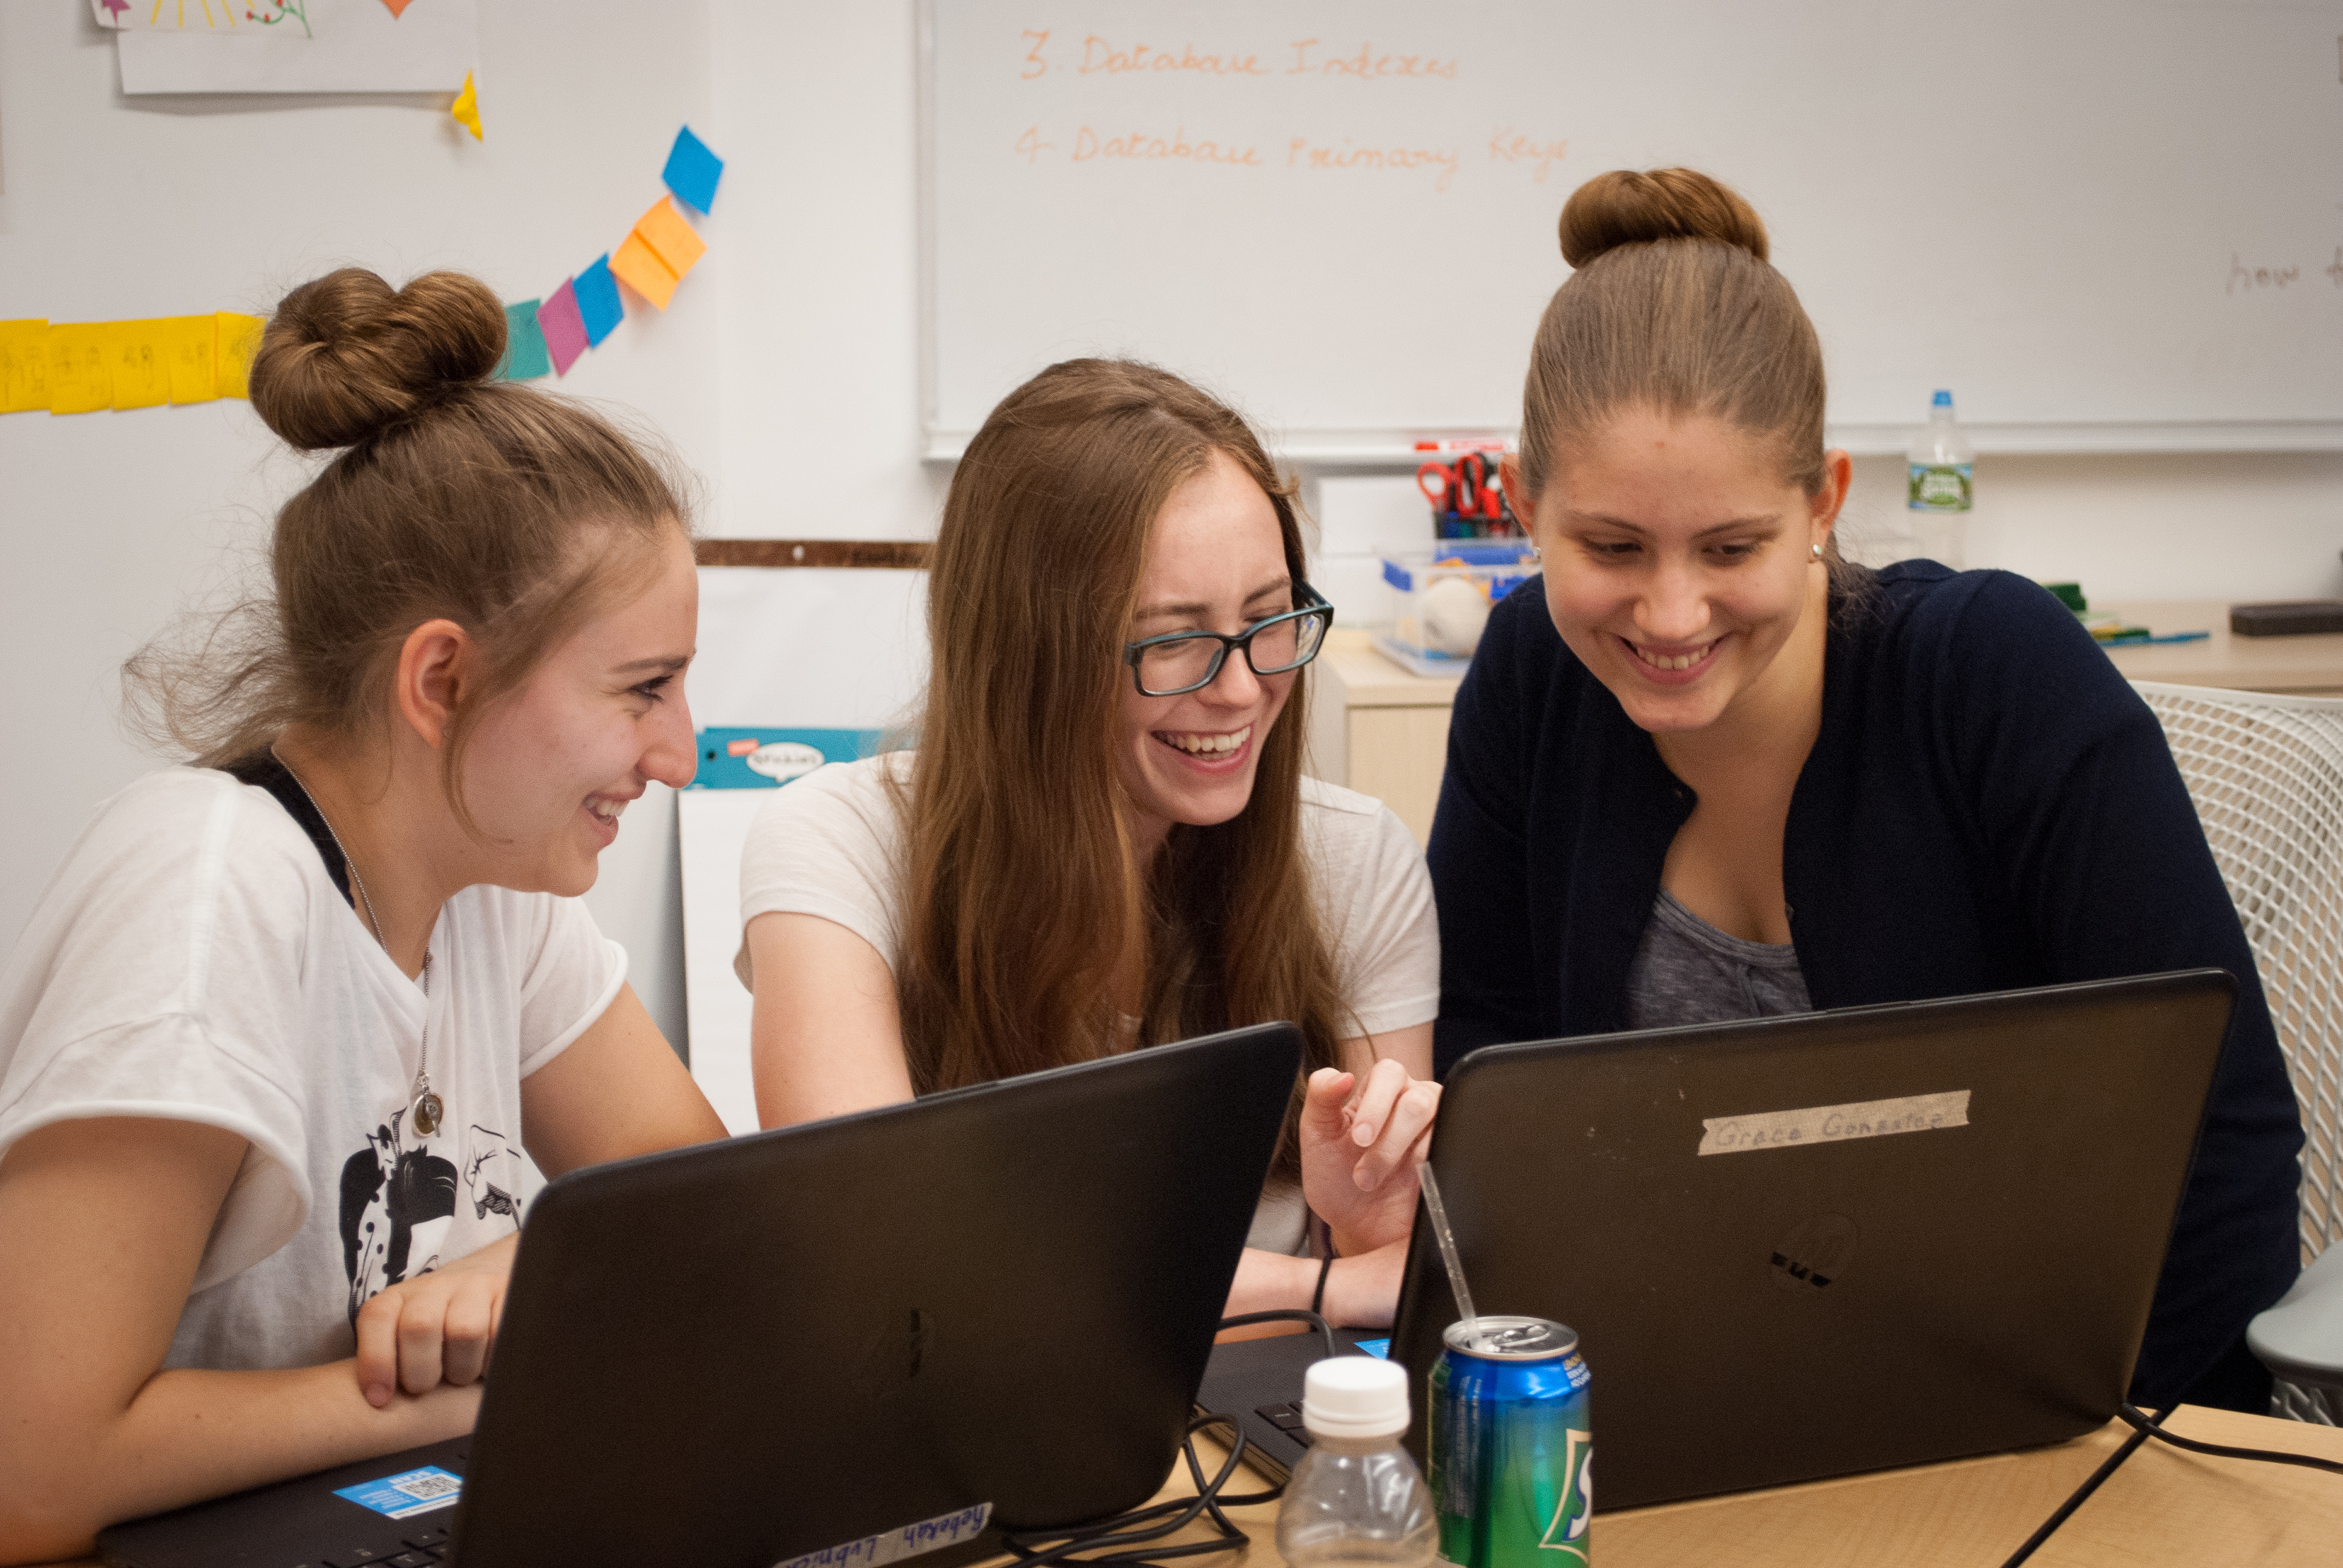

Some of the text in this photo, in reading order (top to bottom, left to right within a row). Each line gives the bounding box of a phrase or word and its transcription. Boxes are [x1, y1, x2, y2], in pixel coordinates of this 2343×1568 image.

[1285, 37, 1458, 80] Indexes
[1287, 136, 1460, 193] Primary
[1488, 125, 1570, 185] Keys
[2226, 250, 2299, 297] how
[1715, 1121, 1802, 1147] Grace
